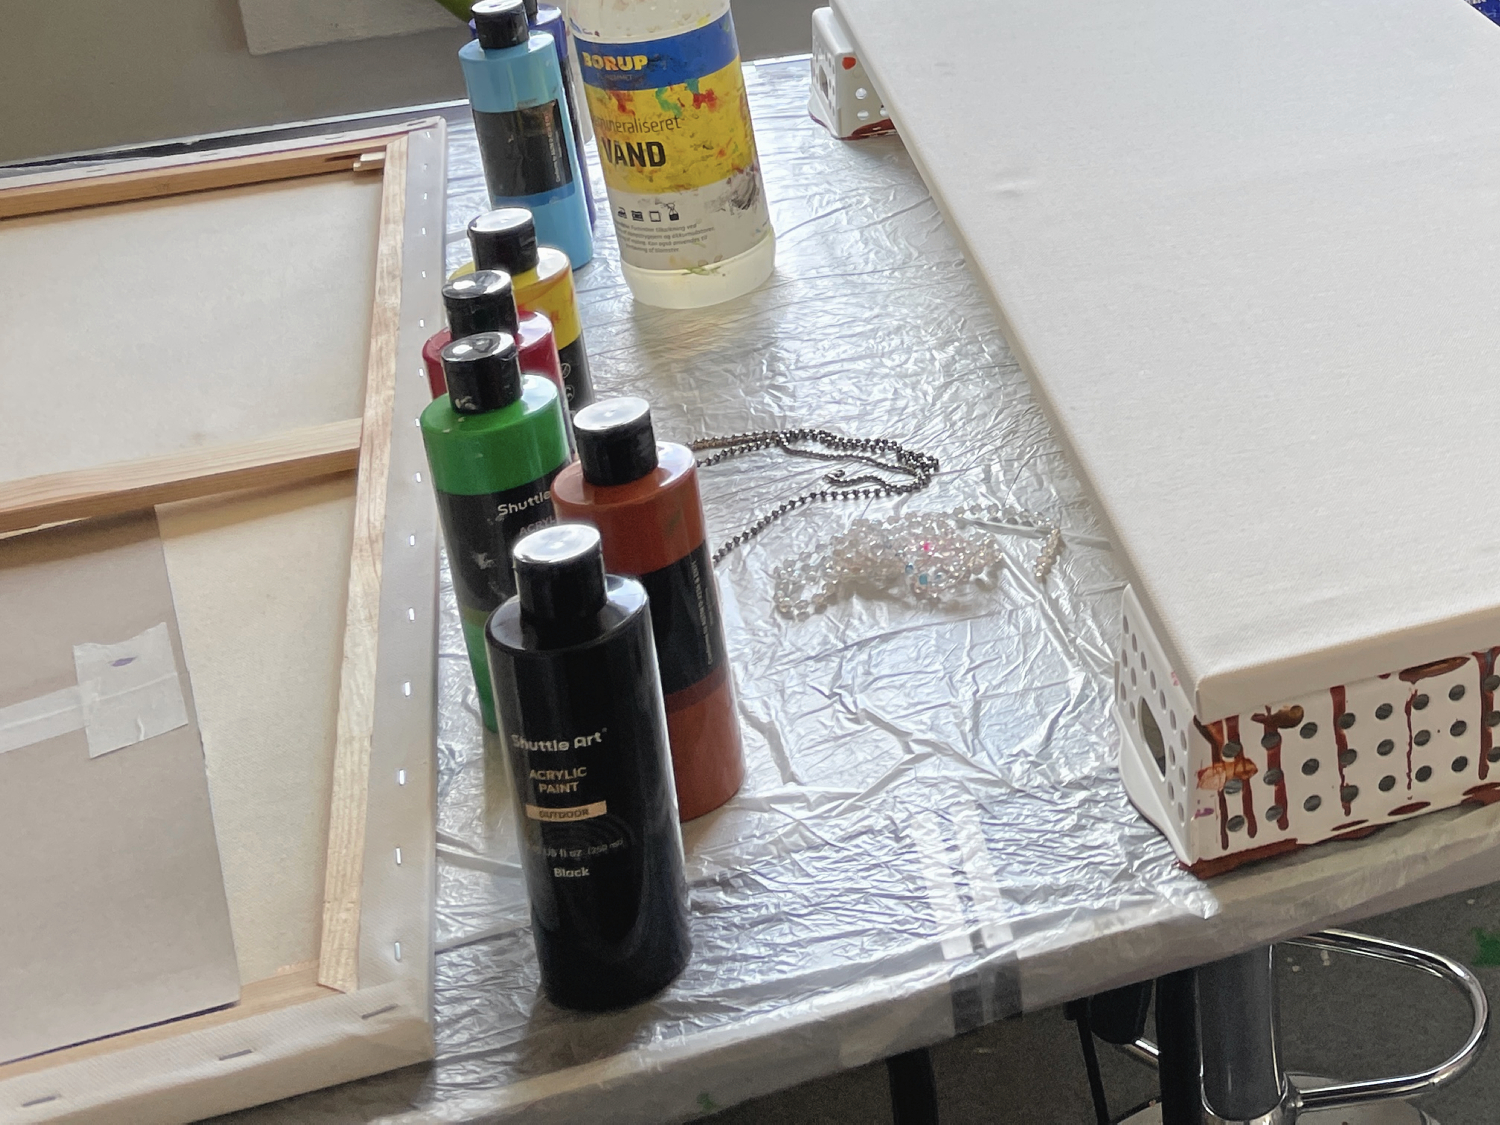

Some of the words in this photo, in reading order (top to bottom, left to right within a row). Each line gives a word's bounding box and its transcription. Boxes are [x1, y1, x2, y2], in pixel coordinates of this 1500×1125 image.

[582, 52, 648, 71] BORUP
[601, 137, 667, 168] VAND
[497, 490, 552, 517] Shuttle
[511, 734, 569, 752] Shuttle
[573, 731, 602, 749] Art
[529, 767, 588, 781] ACRYLIC
[538, 781, 579, 794] PAINT
[539, 808, 589, 819] OUTDOOR
[553, 866, 590, 878] Black
